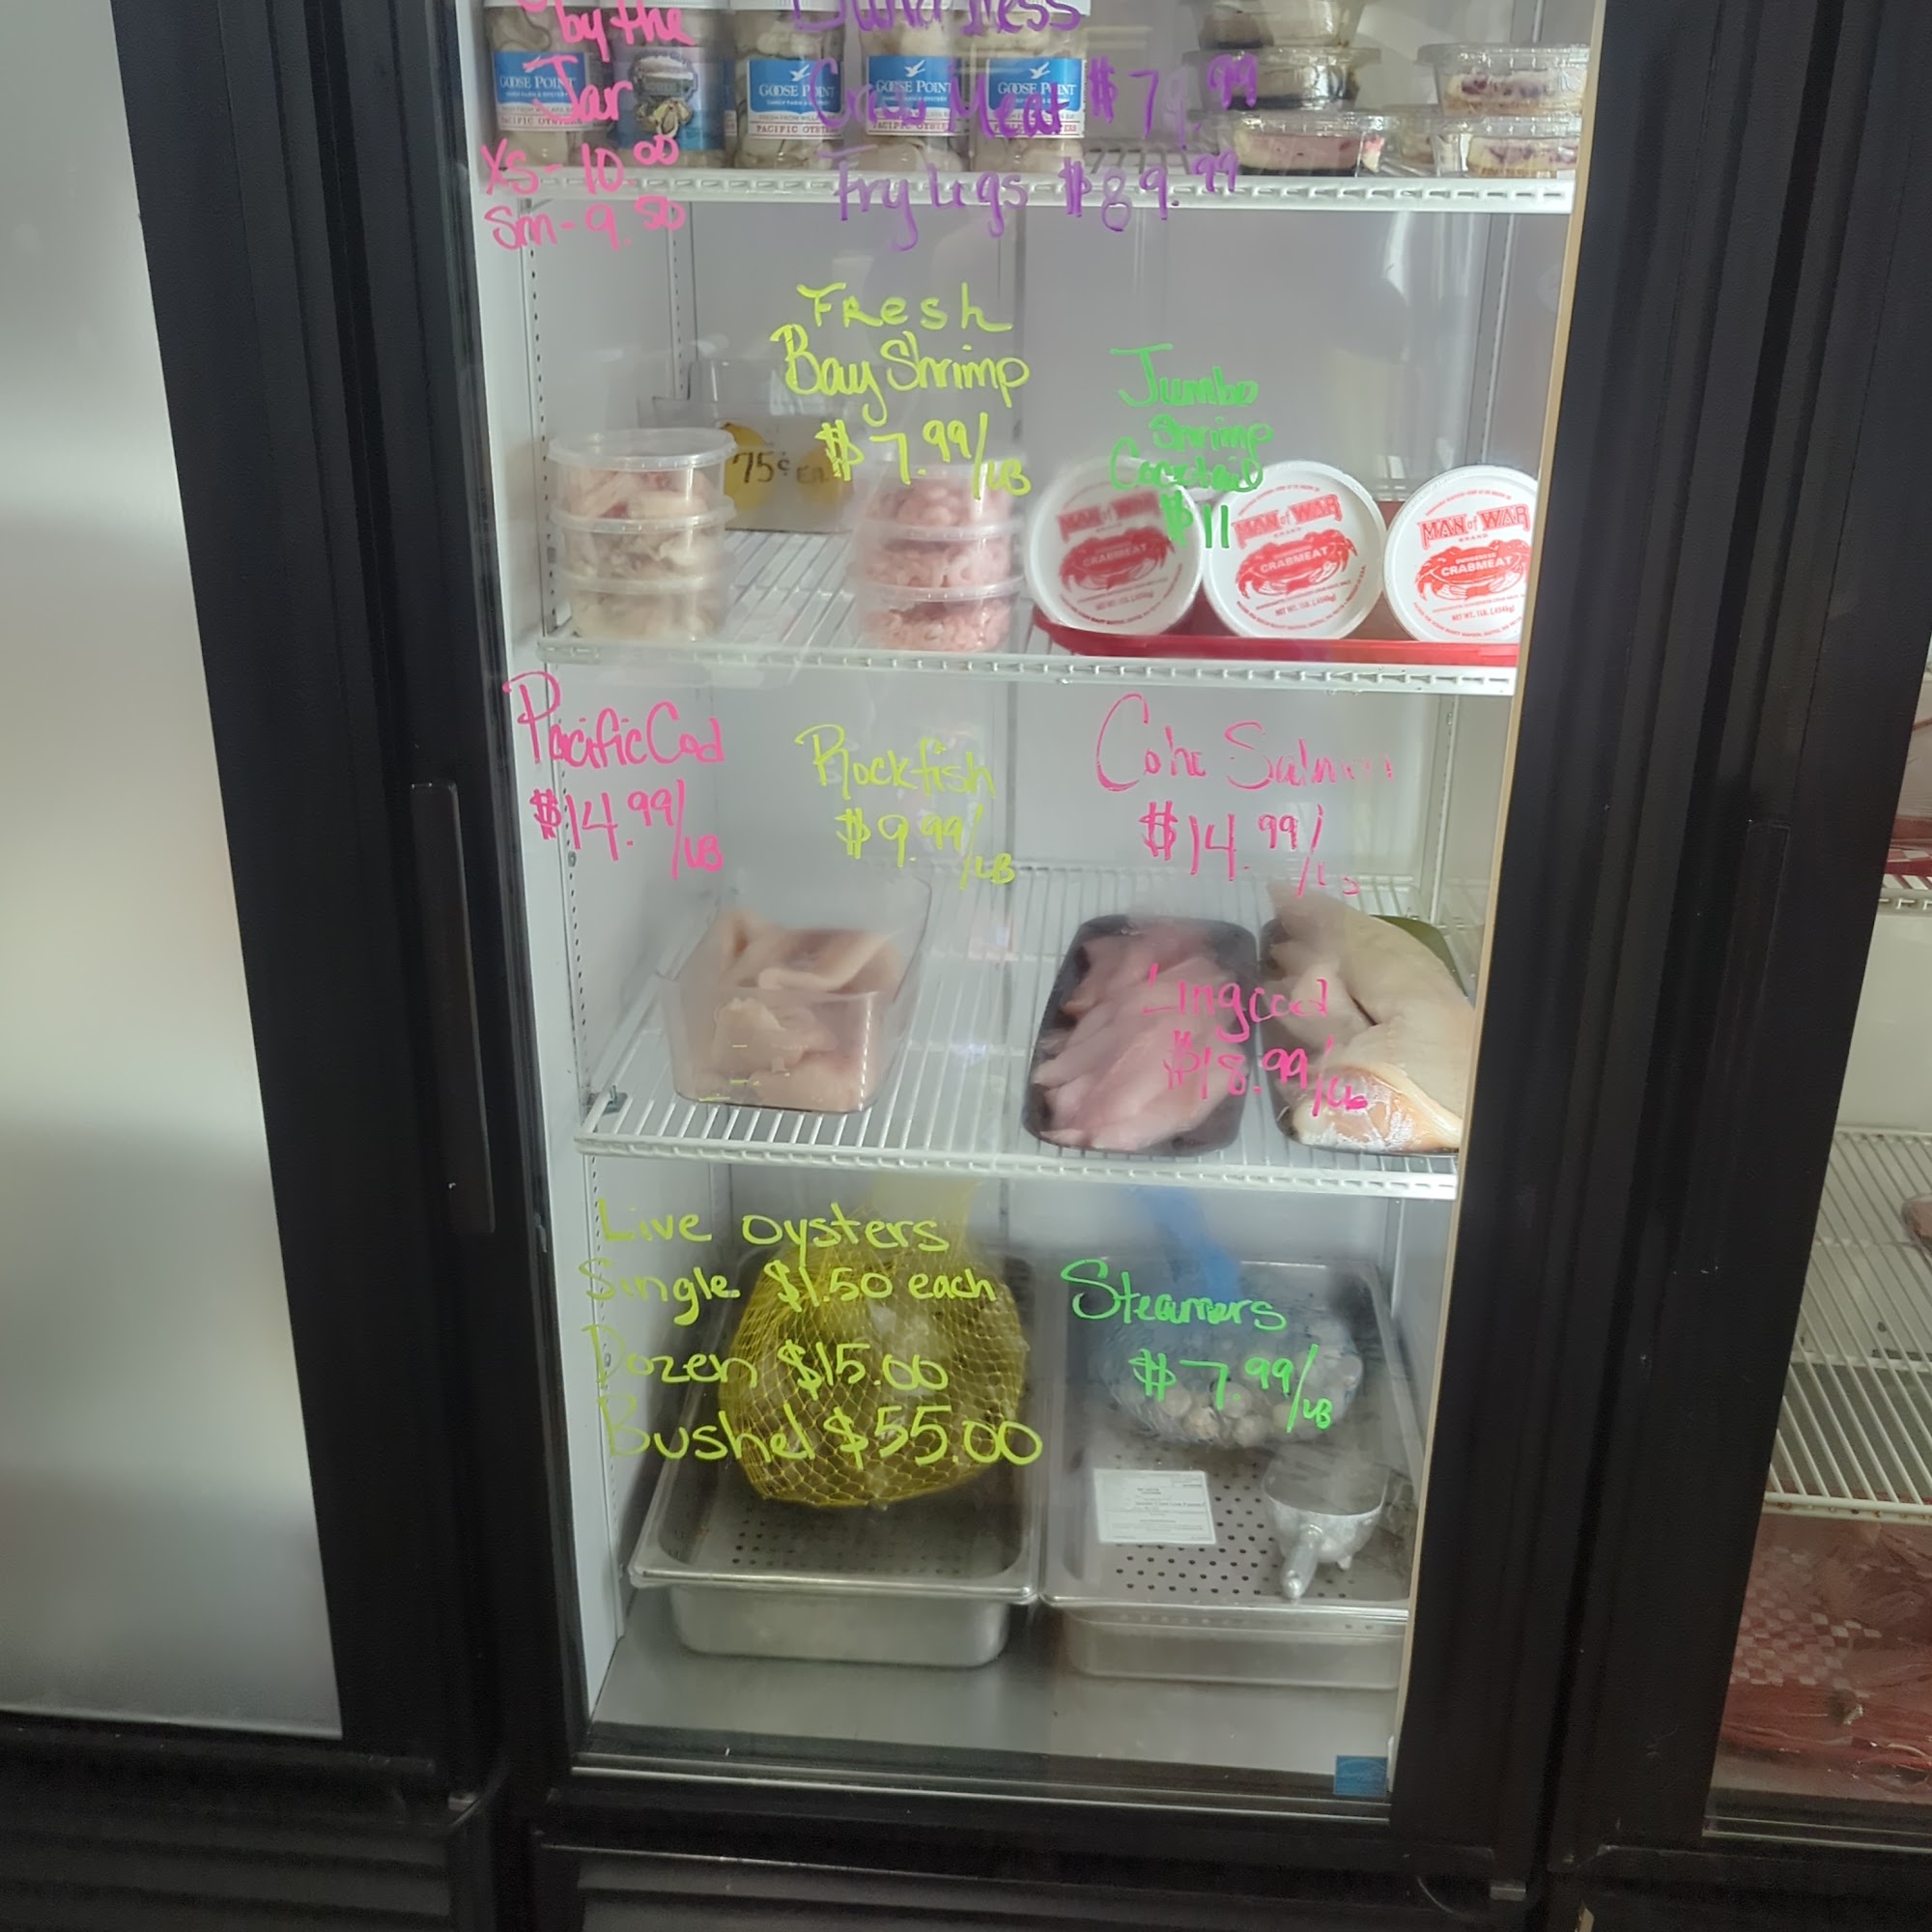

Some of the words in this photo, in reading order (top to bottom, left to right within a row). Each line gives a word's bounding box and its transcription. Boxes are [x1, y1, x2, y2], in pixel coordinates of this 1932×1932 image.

[499, 76, 532, 89] GOOSE
[523, 55, 633, 123] Jar
[758, 84, 799, 97] GOOSE
[917, 80, 952, 93] POINT
[998, 82, 1037, 95] GOOSE
[1040, 82, 1077, 96] PINT
[756, 125, 798, 133] PACIFIC
[770, 324, 888, 427] Bay
[880, 330, 1031, 409] Shrimp
[1110, 343, 1259, 408] Jumbo
[1417, 514, 1467, 550] MAN
[1476, 503, 1530, 531] WAR
[1260, 547, 1329, 574] CRABMEAT
[1440, 555, 1513, 577] CRABMEAT
[502, 670, 647, 769] Pacific
[646, 700, 724, 765] Cod
[794, 724, 996, 800] Rockfish
[597, 1198, 713, 1242] Live
[580, 1257, 741, 1326] Single
[908, 1268, 998, 1302] each
[1061, 1259, 1287, 1331] Steamers
[582, 1323, 757, 1389] Dozen
[778, 1339, 950, 1401] $15.00
[597, 1394, 816, 1463] Bushel
[823, 1405, 1044, 1471] $55.00
